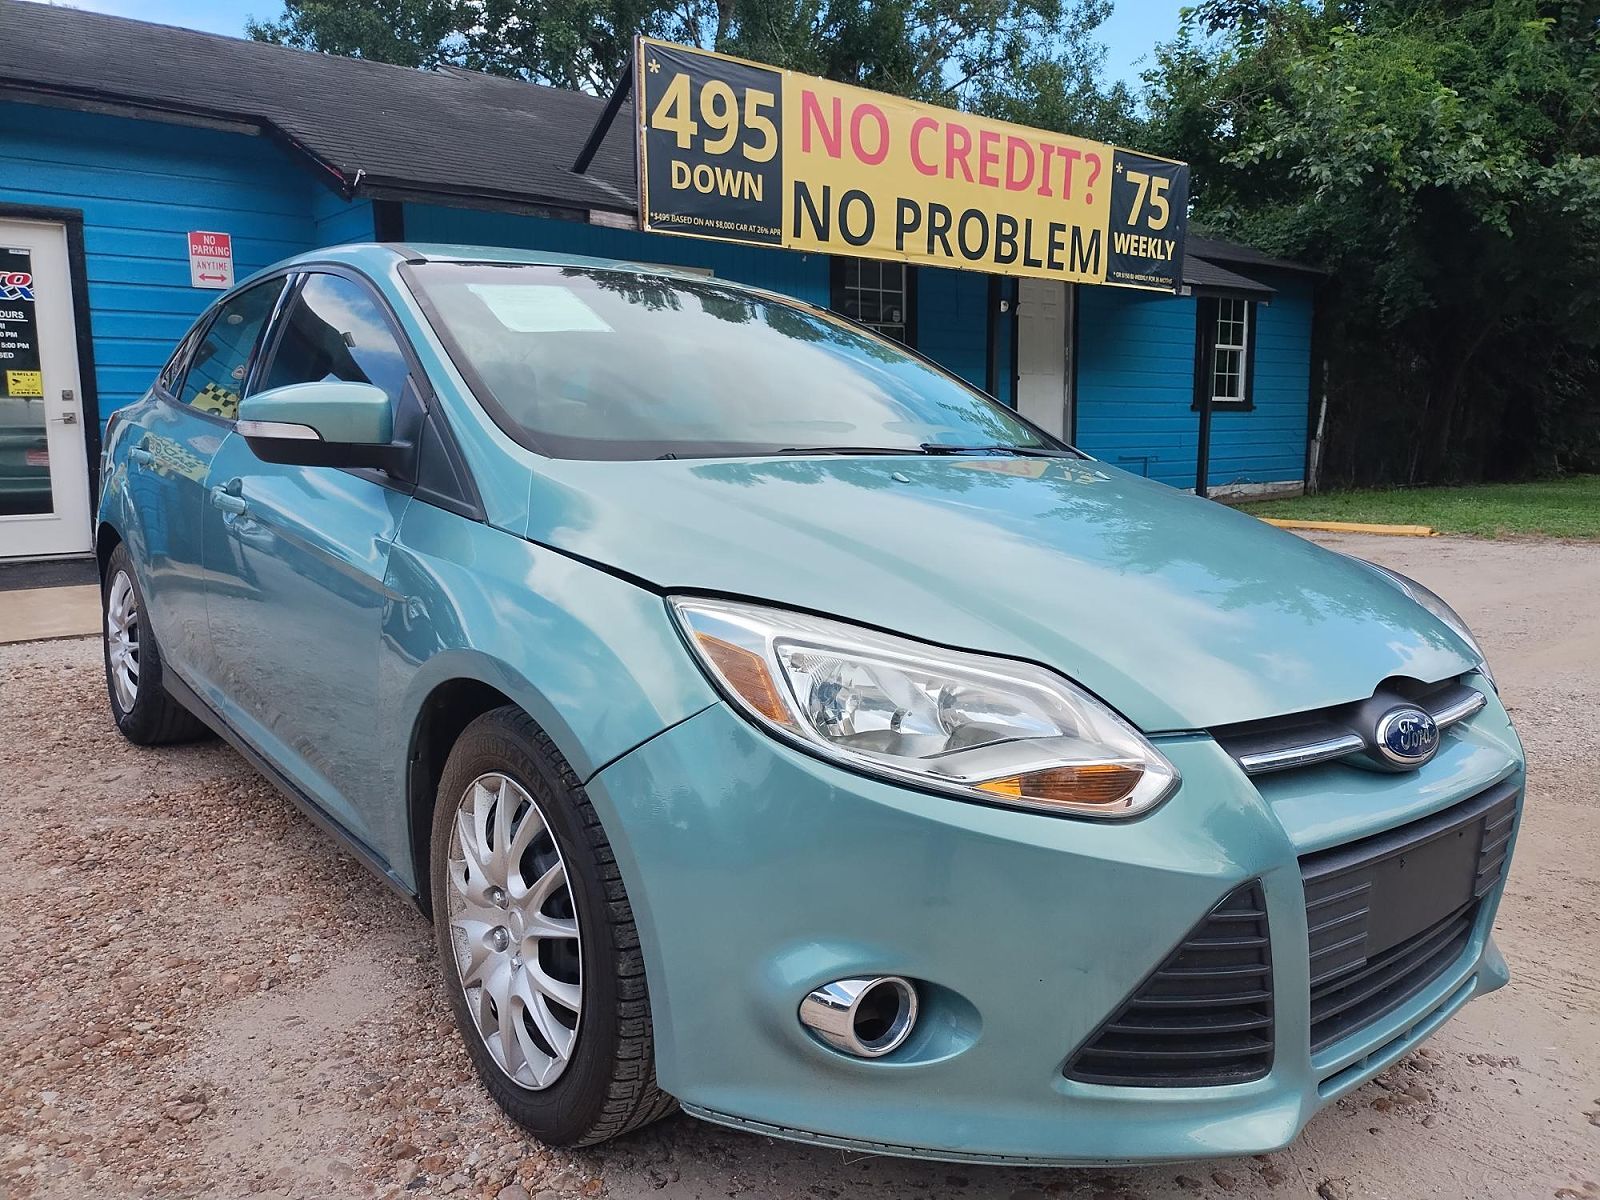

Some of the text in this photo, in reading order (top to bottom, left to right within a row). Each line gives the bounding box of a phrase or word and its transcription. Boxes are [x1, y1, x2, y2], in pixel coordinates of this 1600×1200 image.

[802, 90, 1101, 205] NO CREDIT?
[671, 160, 763, 202] DOWN
[203, 235, 216, 245] NO
[671, 214, 692, 225] BASED
[693, 217, 704, 226] ON
[705, 218, 715, 227] AN
[715, 220, 735, 230] $8,000
[735, 223, 748, 231] CAR
[749, 225, 757, 233] AT
[757, 226, 769, 234] 26%
[769, 227, 781, 236] APR
[793, 180, 1101, 275] NO PROBLEM
[192, 244, 230, 257] PARKING
[1113, 231, 1176, 262] WEEKLY
[197, 260, 228, 271] ANYTIME
[1398, 716, 1433, 751] Ford
